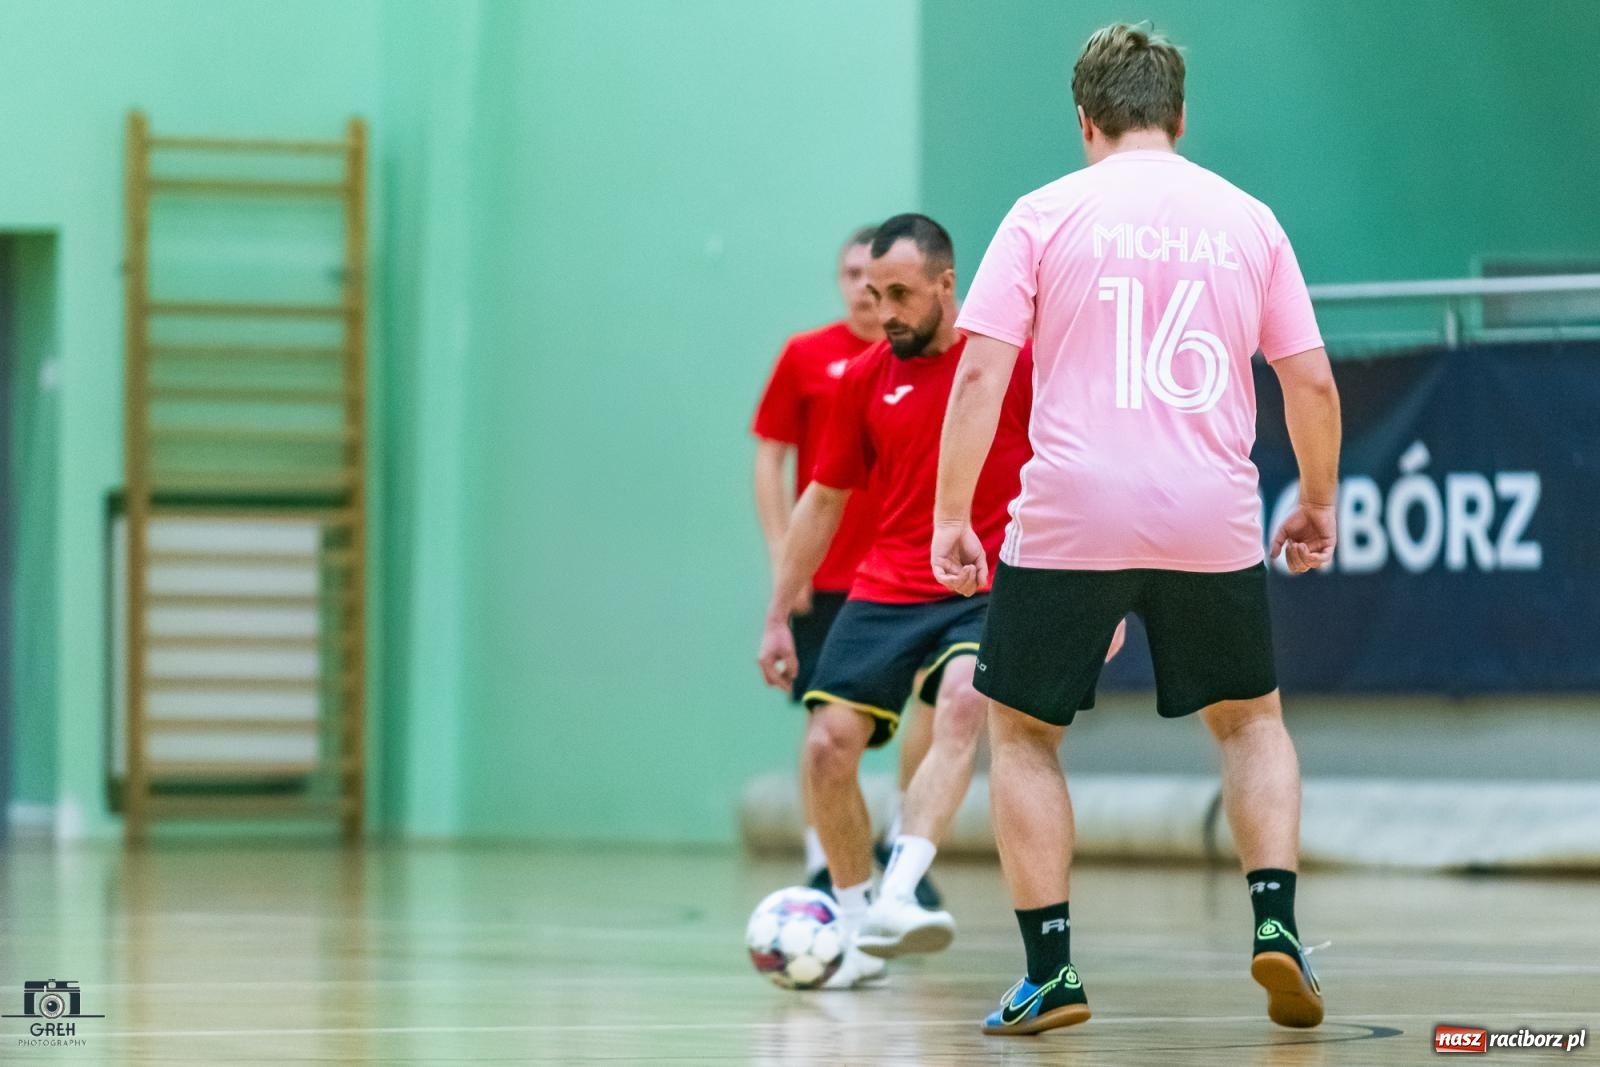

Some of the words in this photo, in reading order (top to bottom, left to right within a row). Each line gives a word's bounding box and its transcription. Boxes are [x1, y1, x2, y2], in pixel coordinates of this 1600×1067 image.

[1091, 223, 1240, 271] MICHAŁ
[1098, 276, 1230, 414] 16
[1257, 440, 1543, 574] BÓRZ
